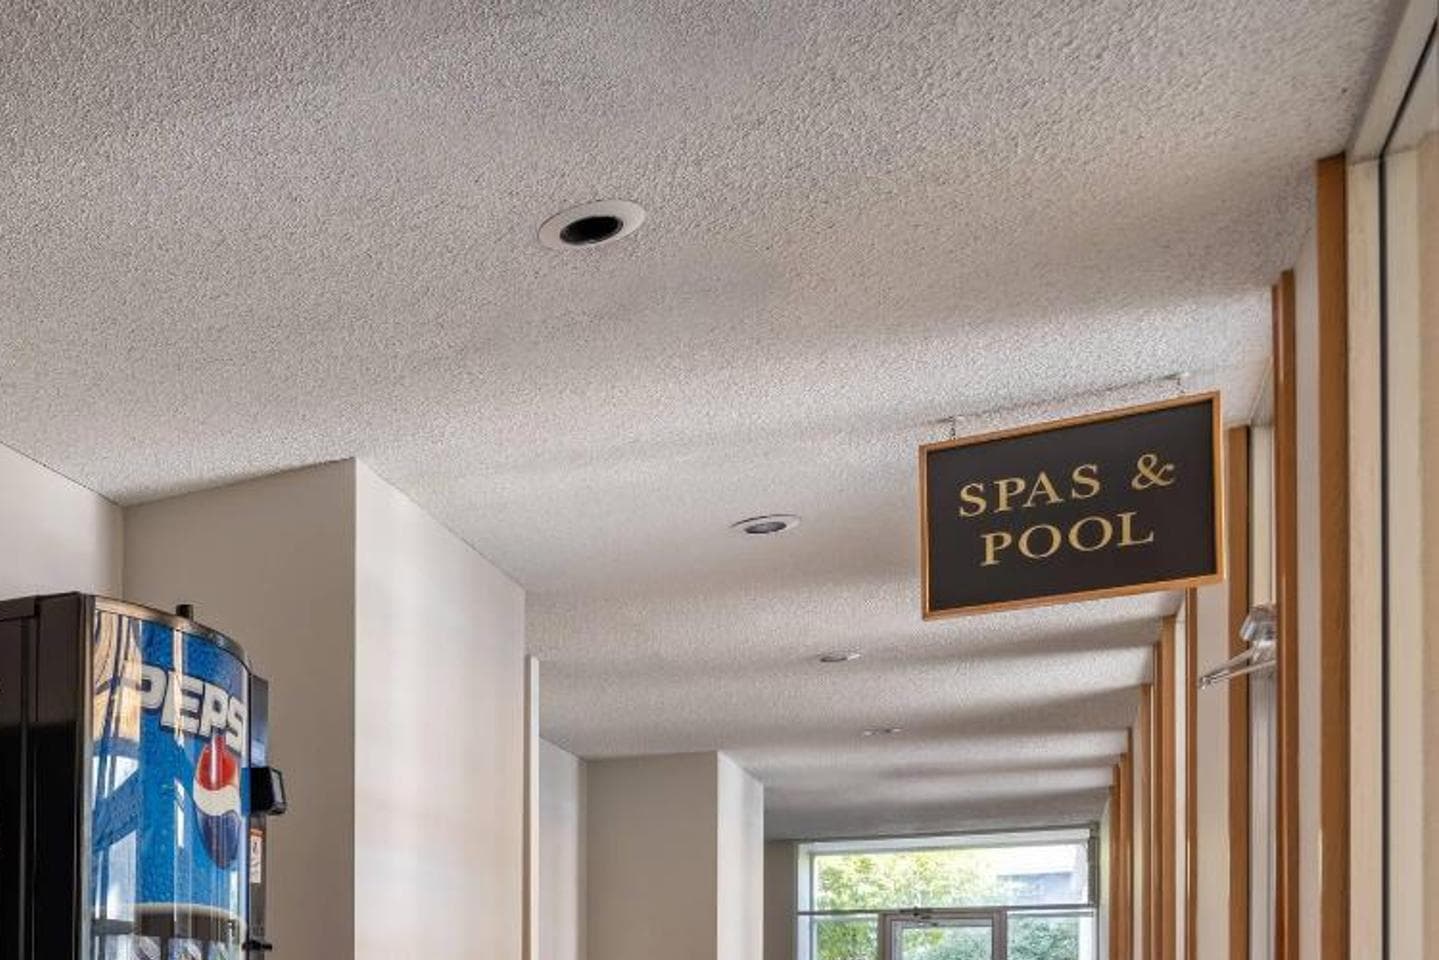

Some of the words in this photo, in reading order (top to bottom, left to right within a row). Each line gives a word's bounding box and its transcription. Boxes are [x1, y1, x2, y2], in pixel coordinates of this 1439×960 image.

[958, 464, 1102, 518] SPAS
[1130, 453, 1175, 491] &
[979, 510, 1154, 567] POOL
[121, 662, 248, 754] PEPS
